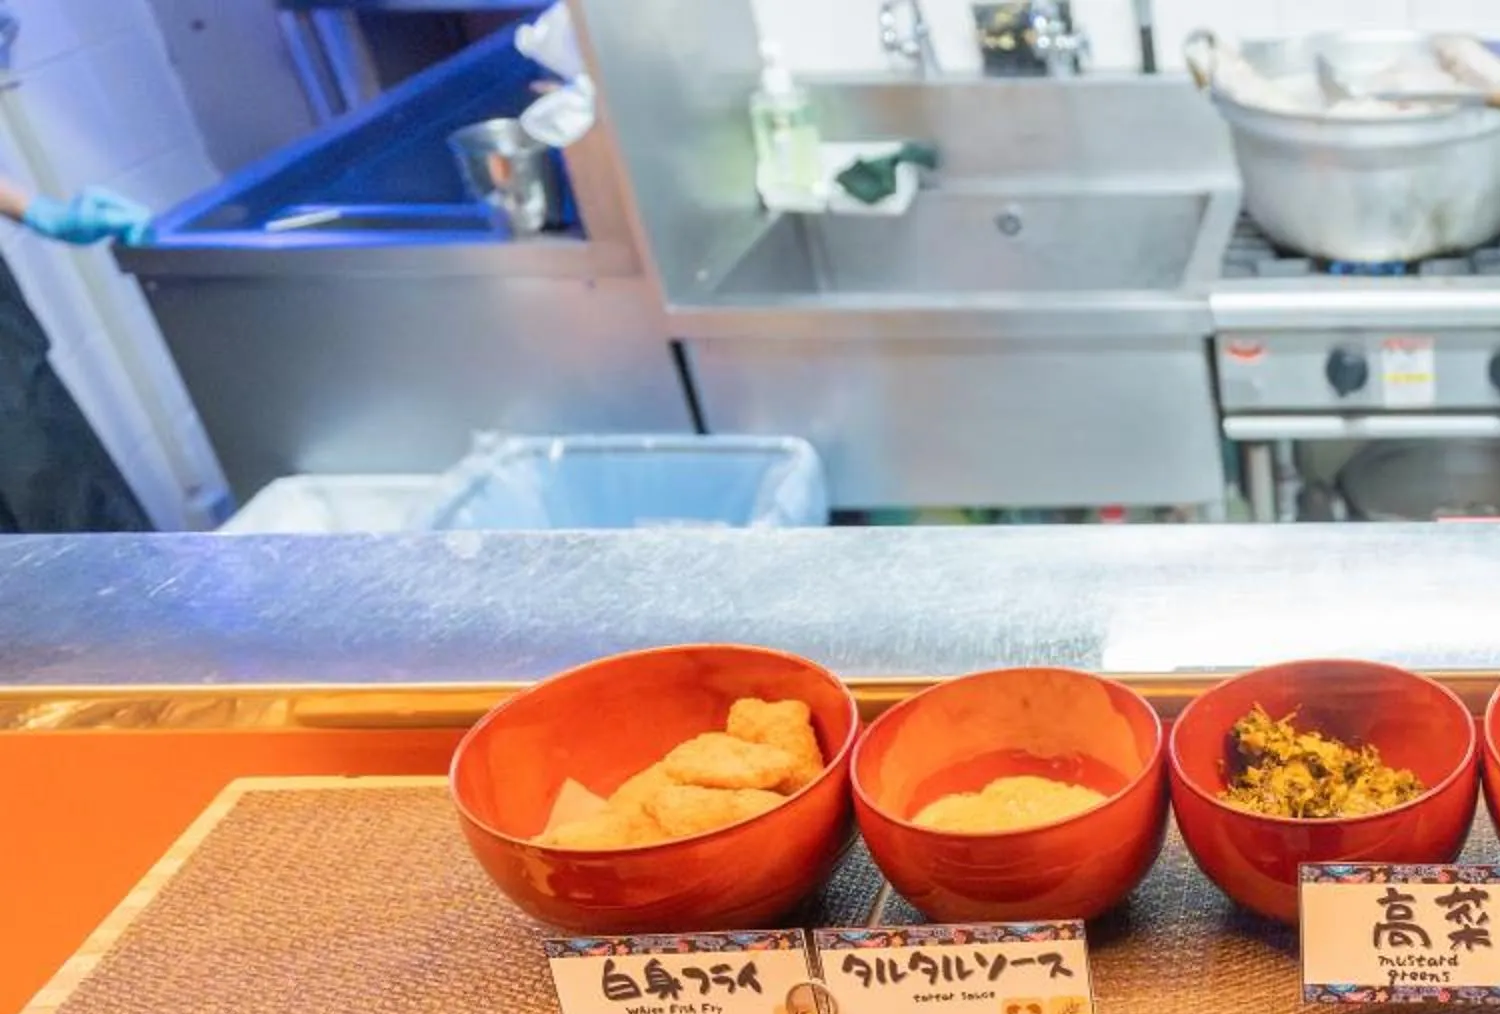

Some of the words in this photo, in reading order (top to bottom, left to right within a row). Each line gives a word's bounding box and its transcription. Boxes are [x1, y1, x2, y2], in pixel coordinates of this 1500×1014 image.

[1373, 886, 1492, 951] 高菜
[842, 951, 1073, 988] タルタルソース
[1378, 954, 1459, 967] mustard
[602, 958, 762, 1000] 白身フライ
[1388, 969, 1450, 987] greens
[670, 1004, 696, 1014] Fish
[702, 1003, 723, 1014] Fry
